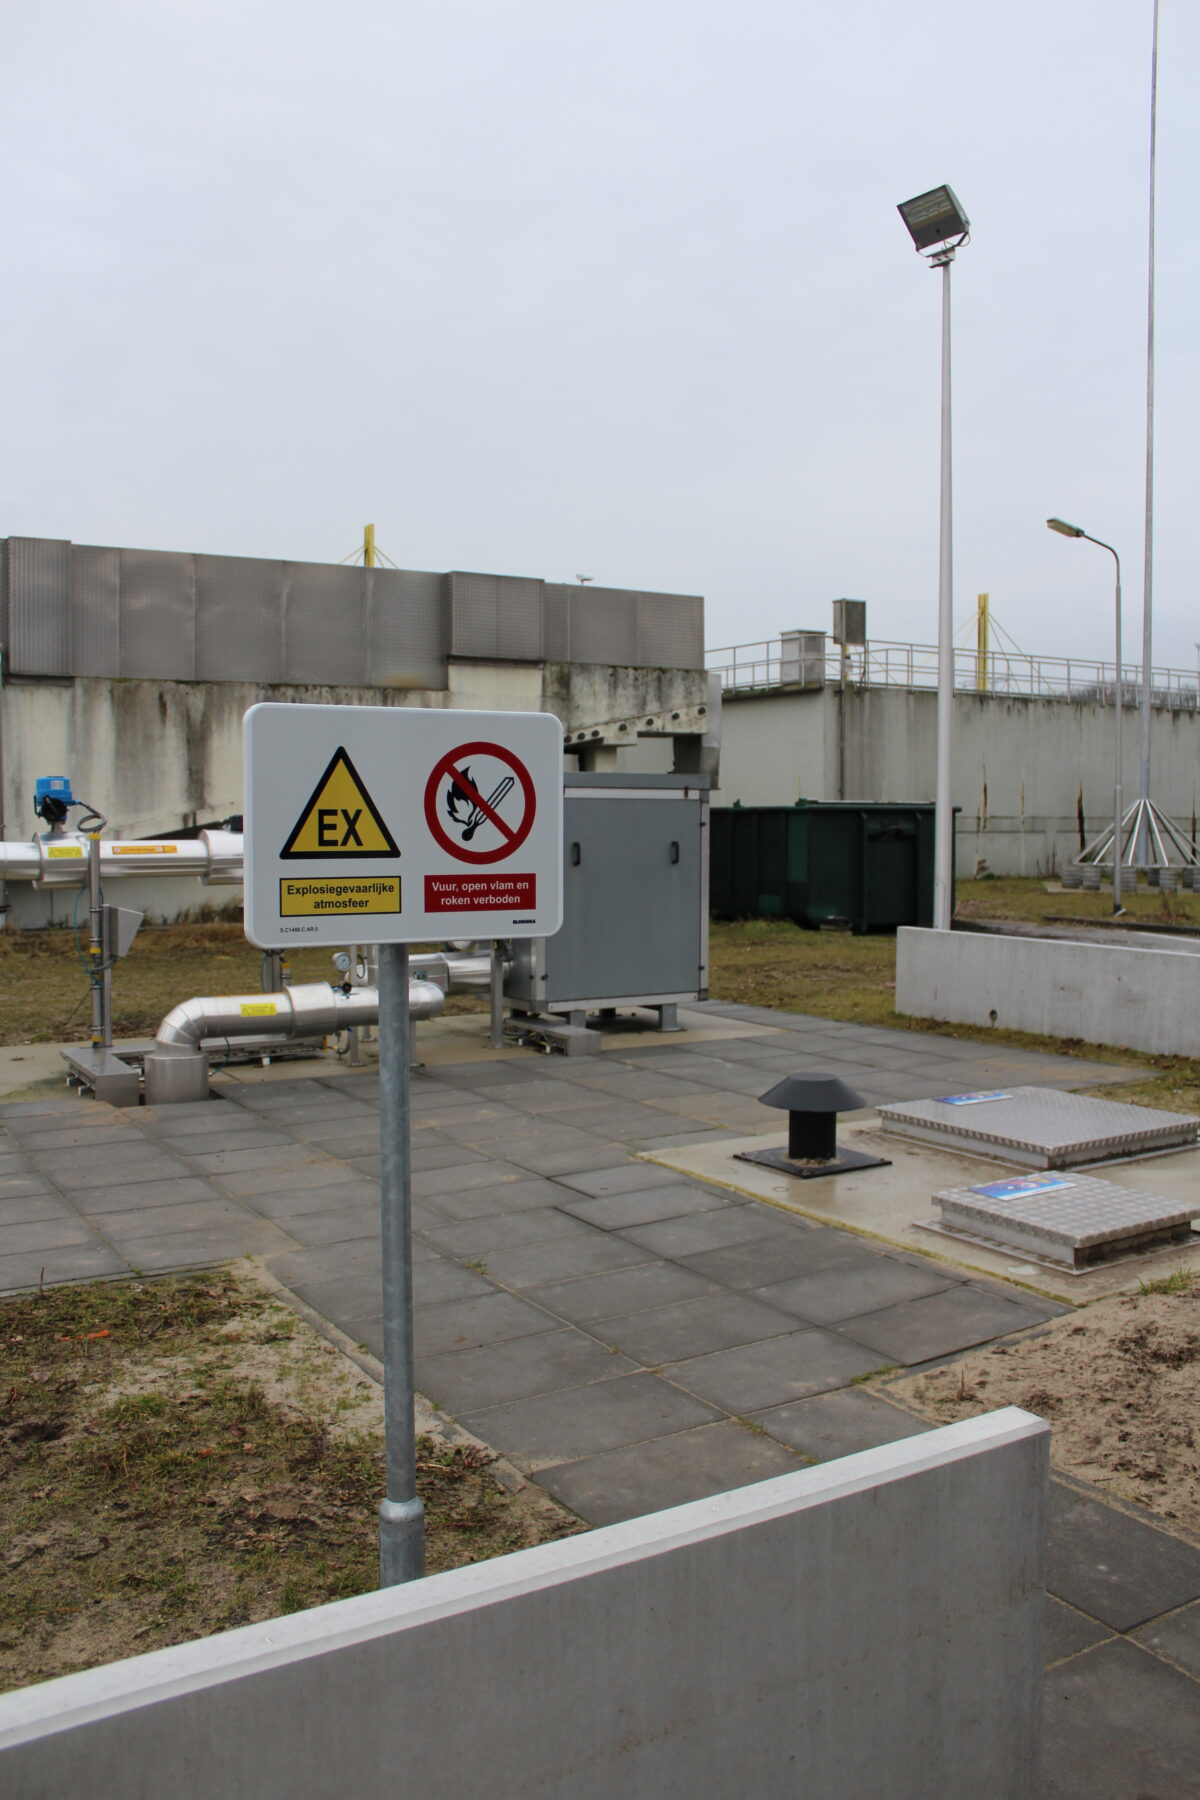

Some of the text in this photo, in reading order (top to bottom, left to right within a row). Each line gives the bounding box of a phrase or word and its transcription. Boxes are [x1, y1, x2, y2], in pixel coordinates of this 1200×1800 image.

[317, 809, 364, 847] EX
[287, 883, 394, 897] Explosiegevaarlijke
[432, 881, 529, 892] Vuur, open vlam en
[313, 899, 370, 909] atmosfeer
[441, 894, 521, 905] roken verboden
